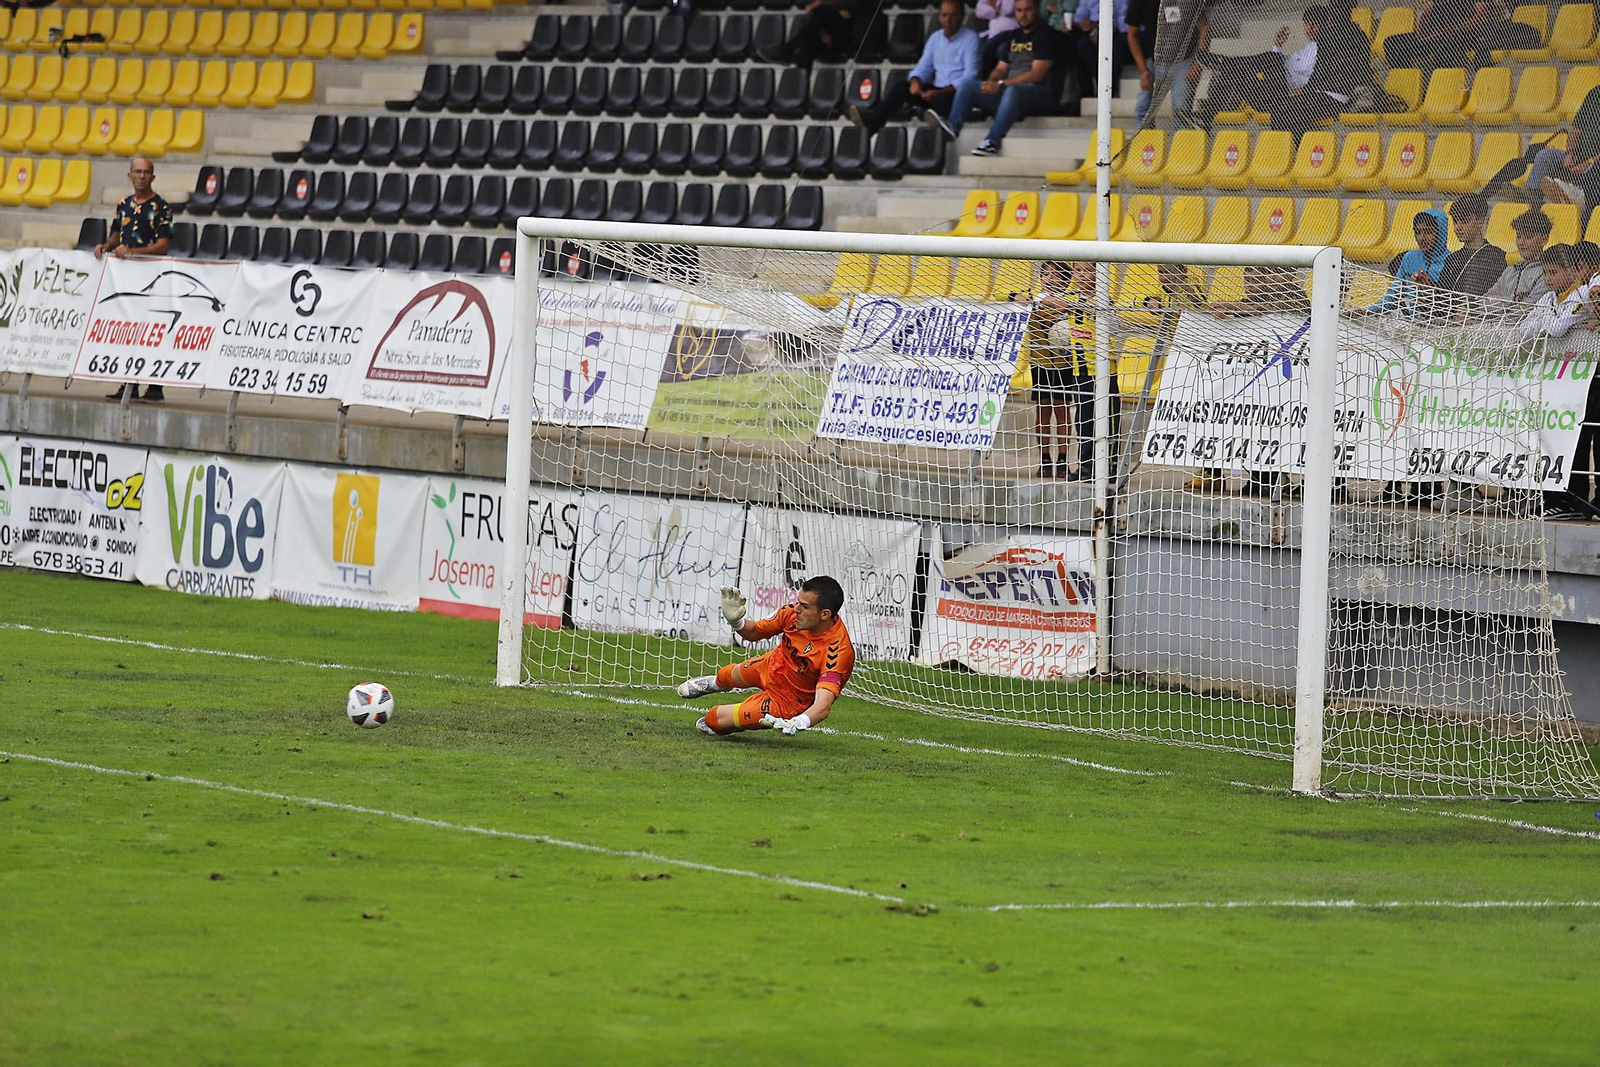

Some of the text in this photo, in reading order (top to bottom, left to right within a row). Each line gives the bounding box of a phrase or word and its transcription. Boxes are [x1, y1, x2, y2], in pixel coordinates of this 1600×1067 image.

[33, 259, 90, 296] VÉLEZ
[408, 320, 473, 345] Panadería
[88, 354, 118, 374] 636
[125, 356, 146, 376] 99
[150, 360, 174, 378] 27
[176, 362, 200, 380] 47
[444, 354, 482, 370] Mercedes
[229, 367, 328, 394] 623 34 15 59
[871, 396, 904, 419] 685
[946, 401, 978, 424] 493
[1154, 399, 1210, 424] MASAJES
[1210, 400, 1284, 426] DEPORTIVOS
[821, 418, 993, 448] info@desguaceslepe.com
[1148, 434, 1188, 459] 676
[1191, 436, 1218, 461] 45
[1226, 437, 1250, 462] 14
[1257, 440, 1280, 464] 72
[19, 446, 108, 492] ELECTRO
[1408, 448, 1445, 476] 959
[1450, 450, 1490, 475] 07
[1490, 454, 1528, 481] 45
[164, 463, 265, 574] Vibe
[22, 529, 40, 542] AIRE
[33, 550, 63, 568] 678
[108, 561, 123, 578] 41
[337, 565, 372, 586] TH
[429, 548, 496, 590] Josema
[166, 568, 255, 599] CARBURANTES
[941, 566, 1096, 607] EPEXTIN
[869, 602, 904, 618] MODERNA
[949, 604, 977, 620] TODO
[1011, 640, 1037, 656] 26
